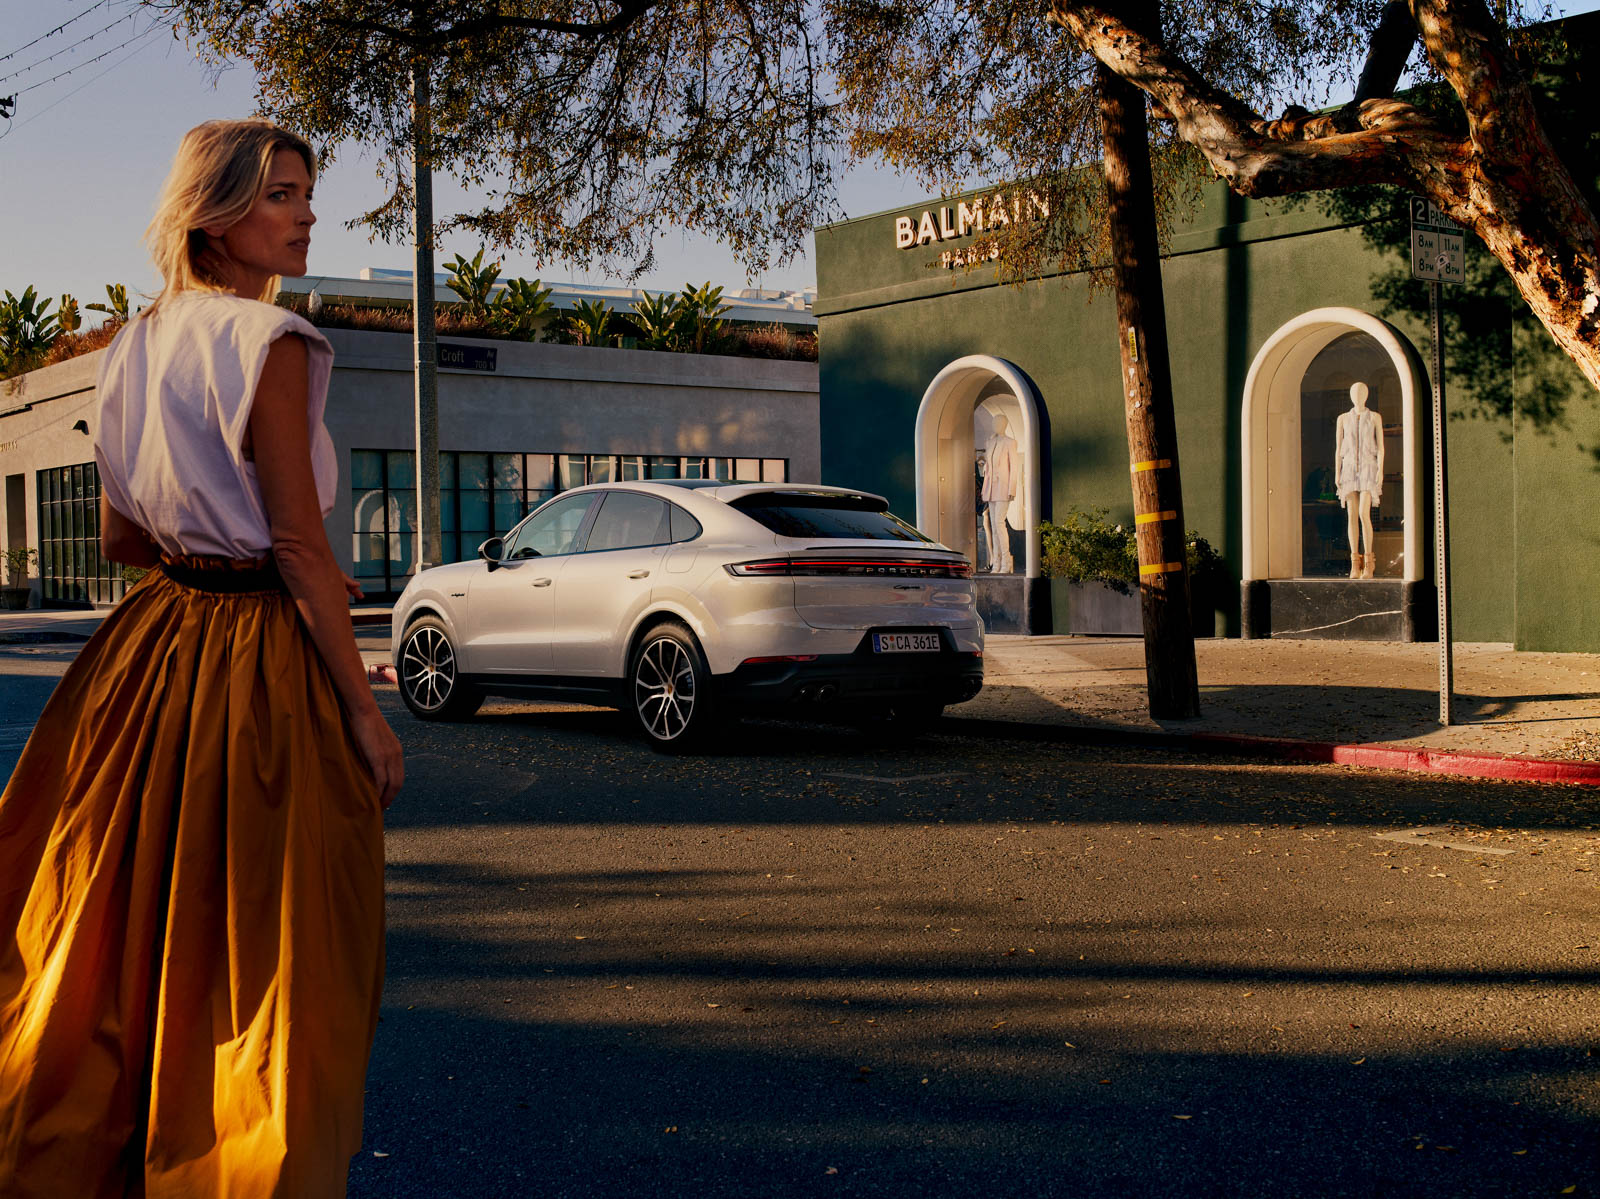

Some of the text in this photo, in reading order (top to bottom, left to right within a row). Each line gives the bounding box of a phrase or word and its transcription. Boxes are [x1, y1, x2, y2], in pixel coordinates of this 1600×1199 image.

[896, 191, 1050, 249] BALMAIN
[1416, 200, 1460, 229] 2 PARKI
[441, 348, 464, 363] Croft
[866, 567, 936, 575] PORSCHE
[881, 636, 889, 650] S
[896, 636, 911, 650] CA
[912, 635, 939, 650] 361E
